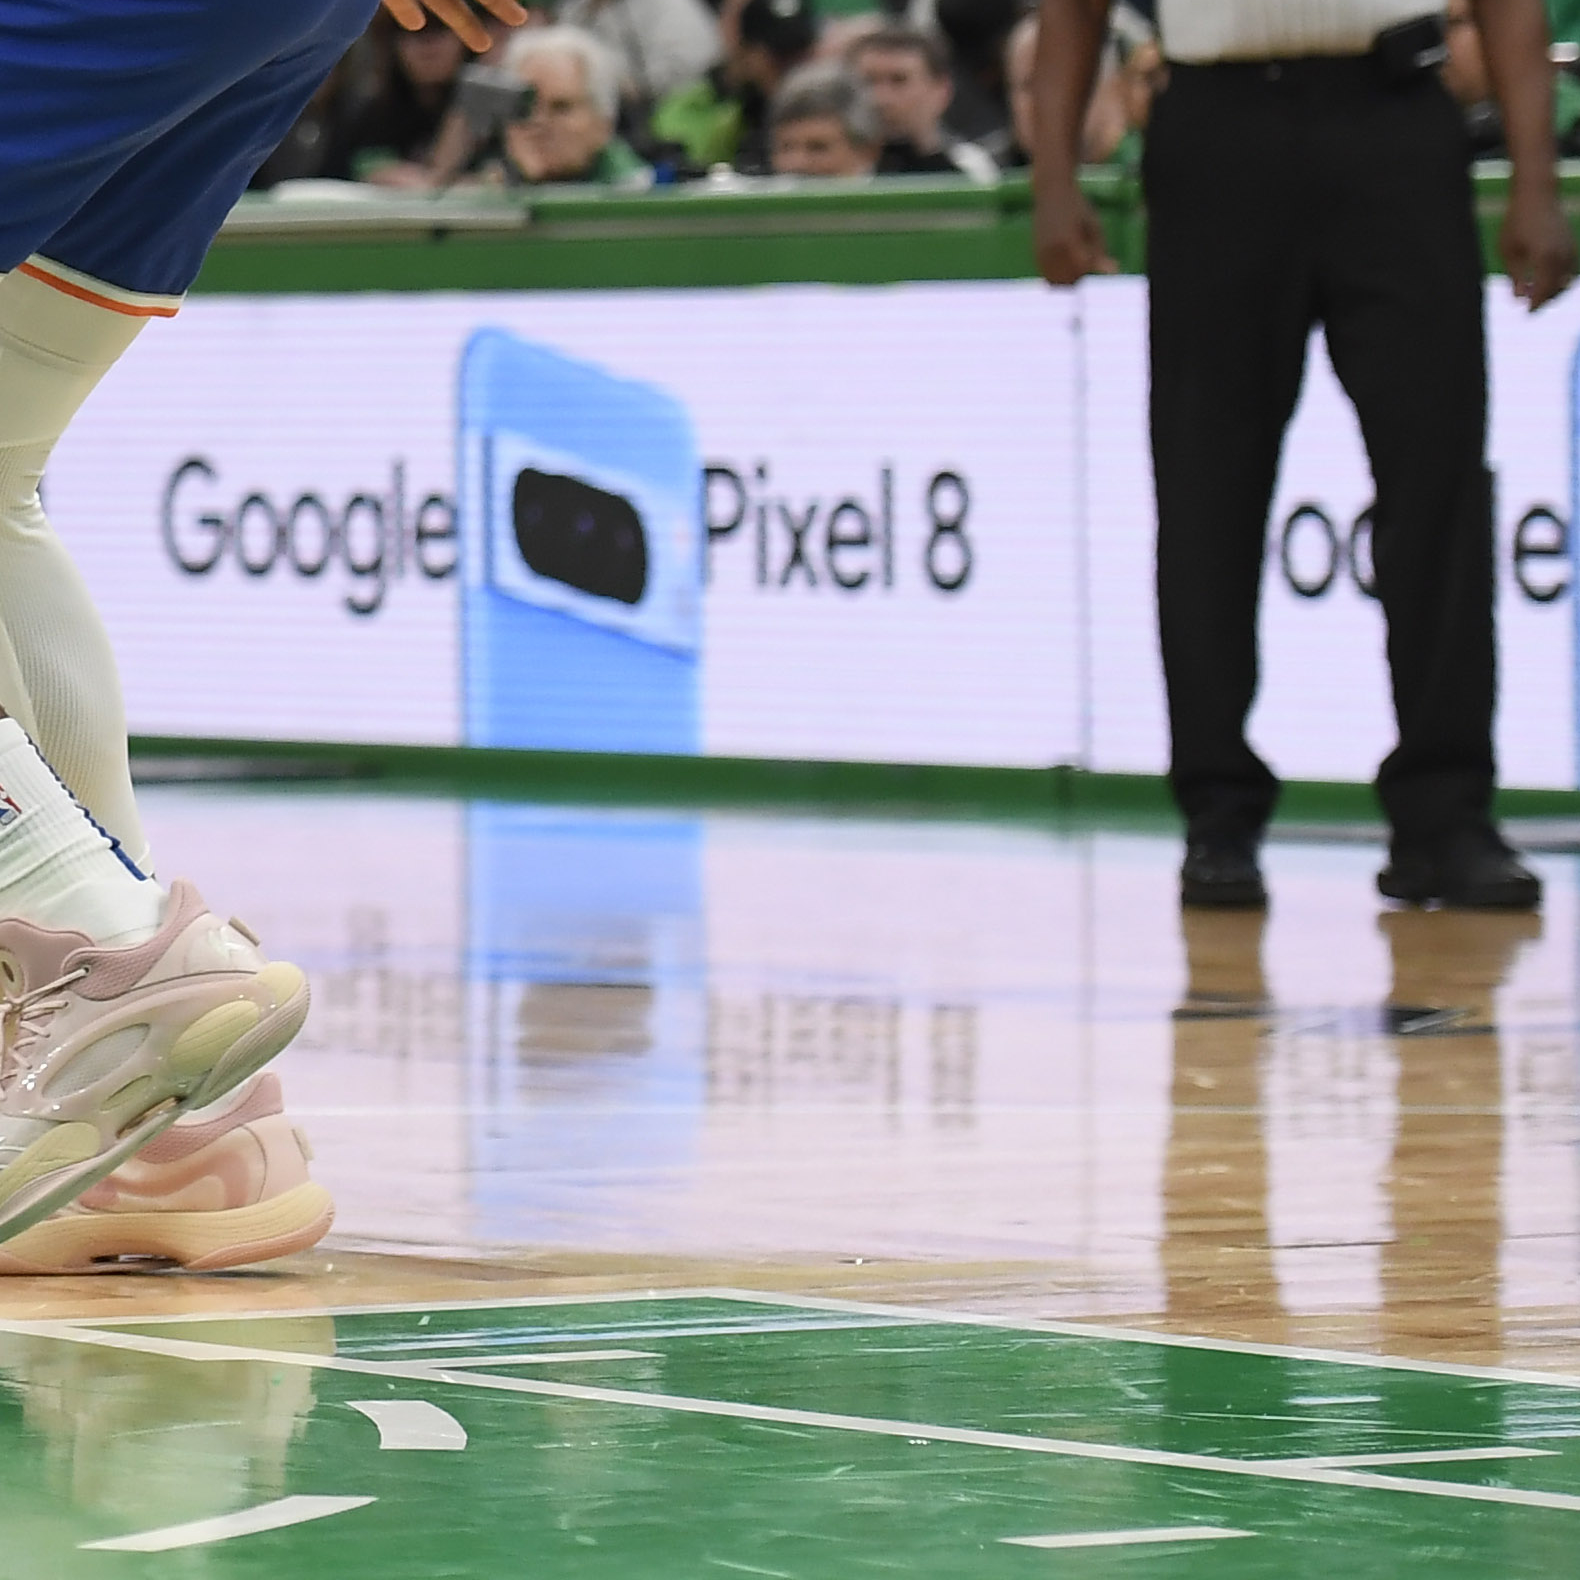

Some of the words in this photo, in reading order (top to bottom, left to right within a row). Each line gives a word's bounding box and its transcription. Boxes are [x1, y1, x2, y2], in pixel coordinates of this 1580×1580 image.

[161, 455, 457, 615] Google
[701, 462, 893, 590] Pixel
[925, 469, 975, 592] 8
